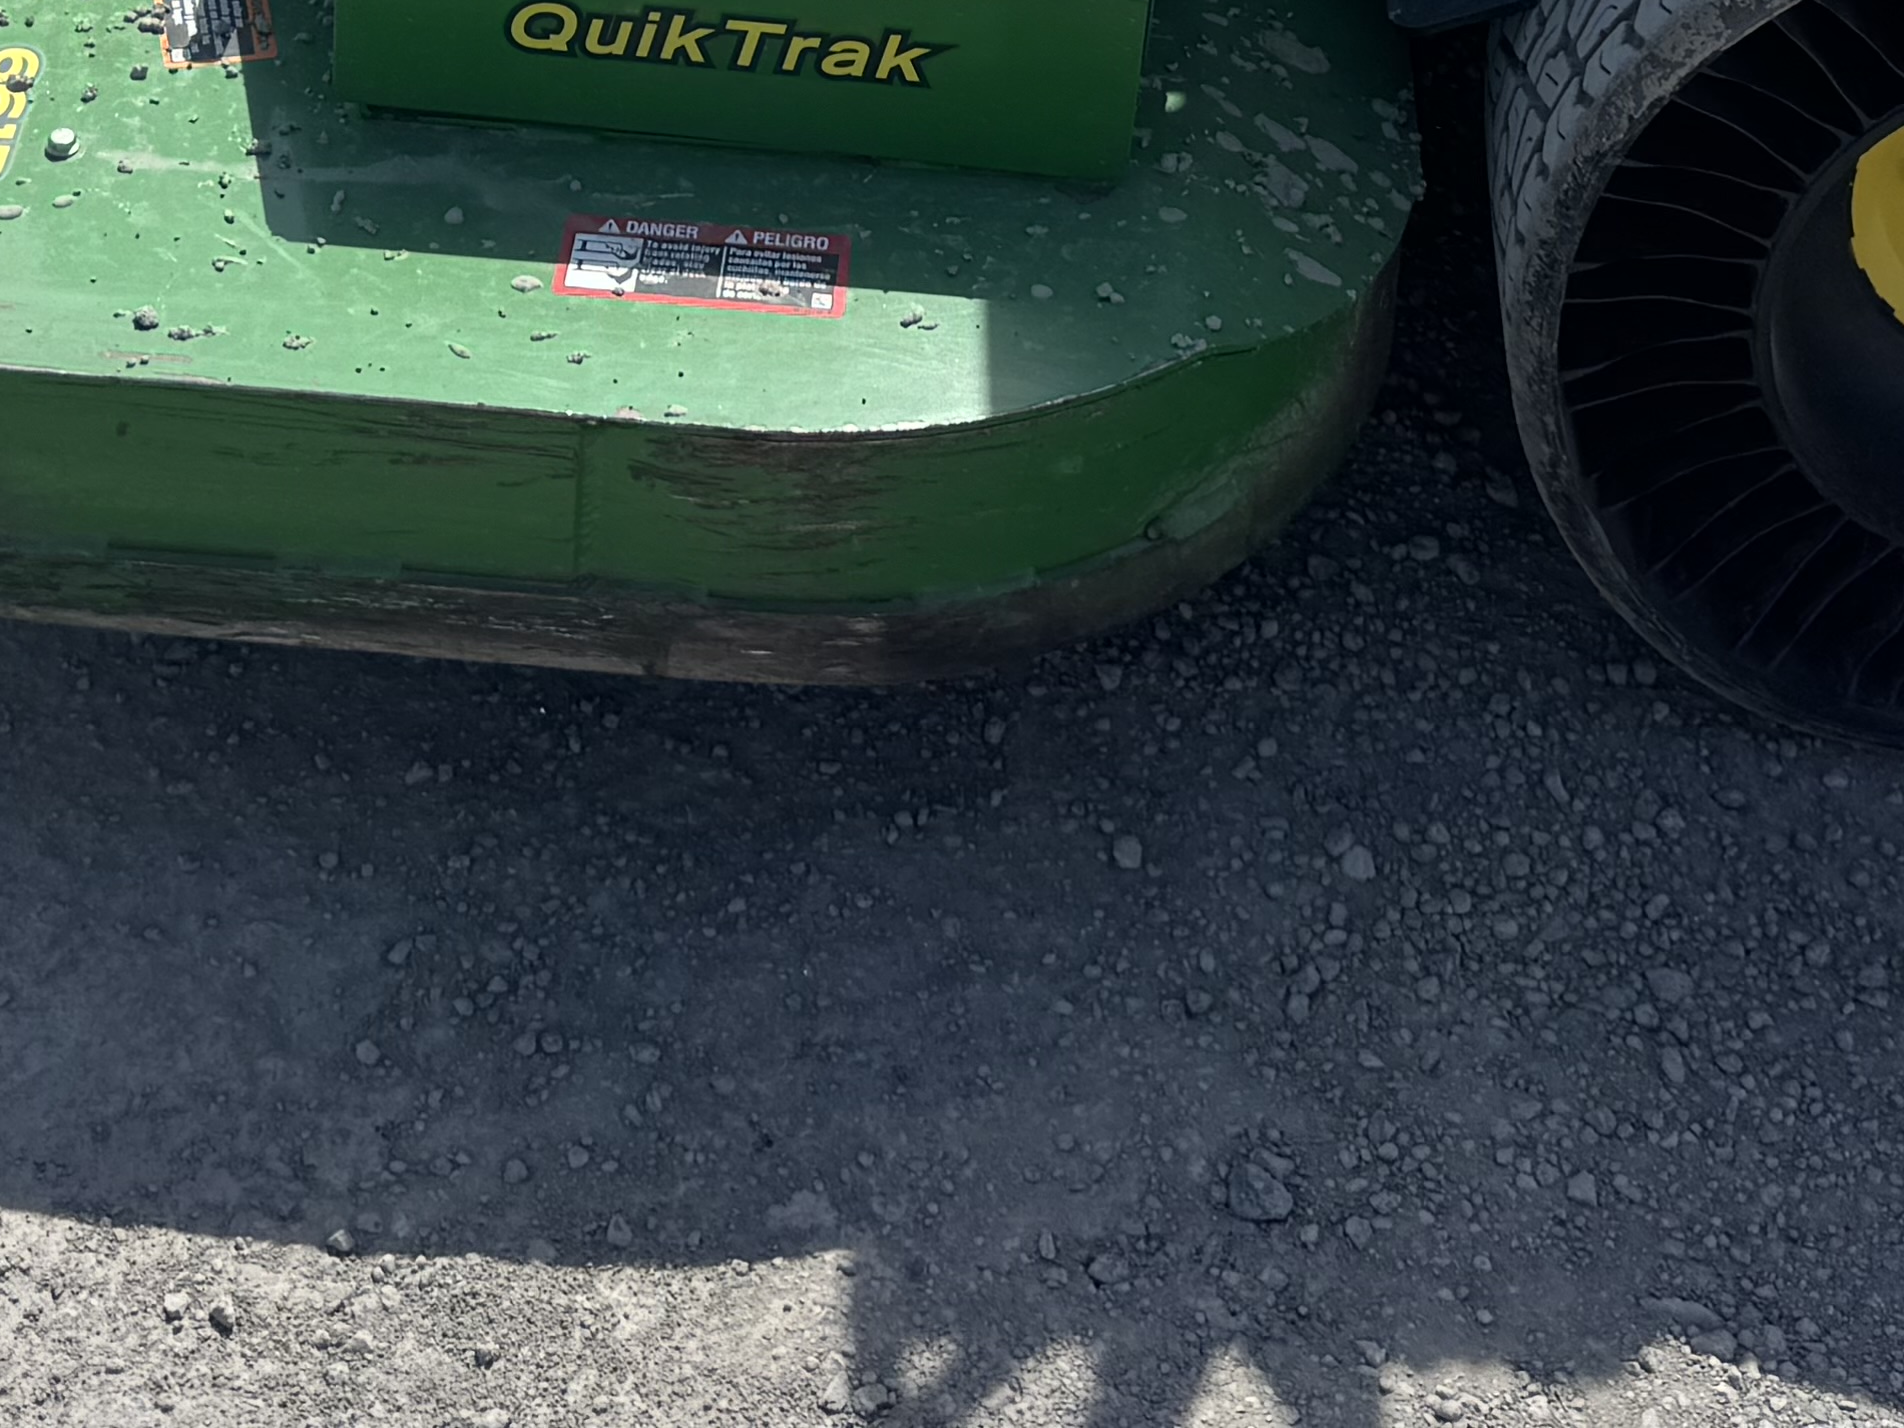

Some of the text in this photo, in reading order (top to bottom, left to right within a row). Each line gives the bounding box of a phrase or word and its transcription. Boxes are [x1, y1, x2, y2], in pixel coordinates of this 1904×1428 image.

[510, 1, 932, 83] QuikTrak
[626, 220, 699, 239] DANGER
[753, 231, 830, 251] PELIGRO
